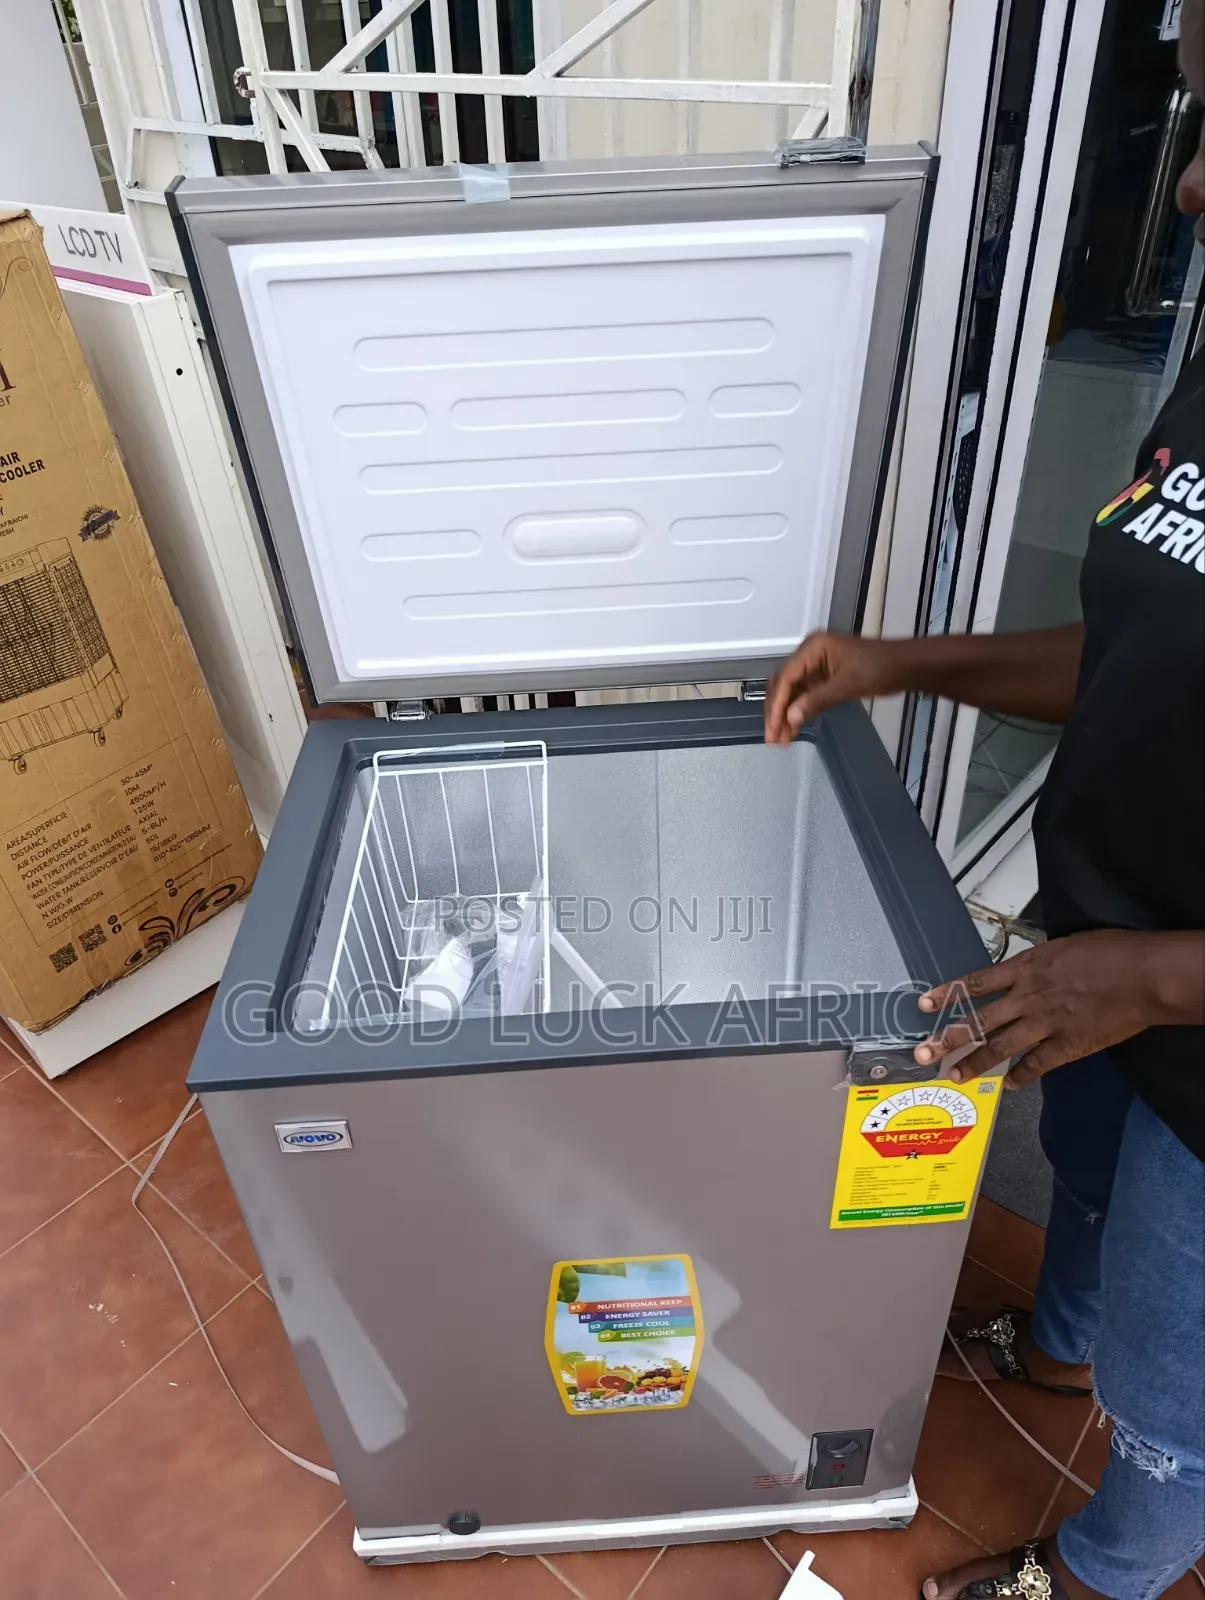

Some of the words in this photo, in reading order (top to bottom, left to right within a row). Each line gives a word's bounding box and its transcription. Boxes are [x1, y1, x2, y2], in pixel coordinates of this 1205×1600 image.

[57, 224, 97, 258] LCD
[94, 230, 123, 263] TV
[0, 451, 21, 467] AIR
[1121, 502, 1205, 574] AFRI
[133, 800, 155, 816] 125W
[138, 810, 159, 826] AXIAL
[6, 811, 68, 851] AREA/SUPERFICIE
[10, 835, 49, 861] DISTANCE
[17, 859, 29, 871] AIR
[72, 822, 92, 838] D'AIR
[21, 836, 90, 880] POWER/PUISSANCE
[26, 879, 43, 891] FAN
[42, 856, 78, 881] TYPE/TYPE
[78, 850, 89, 860] DE
[88, 824, 132, 853] VENTILATEUR
[36, 890, 61, 910] WATER
[118, 843, 139, 861] D'EAU
[30, 886, 49, 900] WATER
[46, 889, 104, 929] SIZE/DIMENSION
[875, 1131, 944, 1144] ENERGY
[937, 1135, 962, 1145] guide
[597, 1301, 659, 1310] NUTRITIONAL
[605, 1311, 641, 1320] ENERGY
[613, 1321, 644, 1329] FREEZE
[643, 1329, 676, 1337] CHOICE
